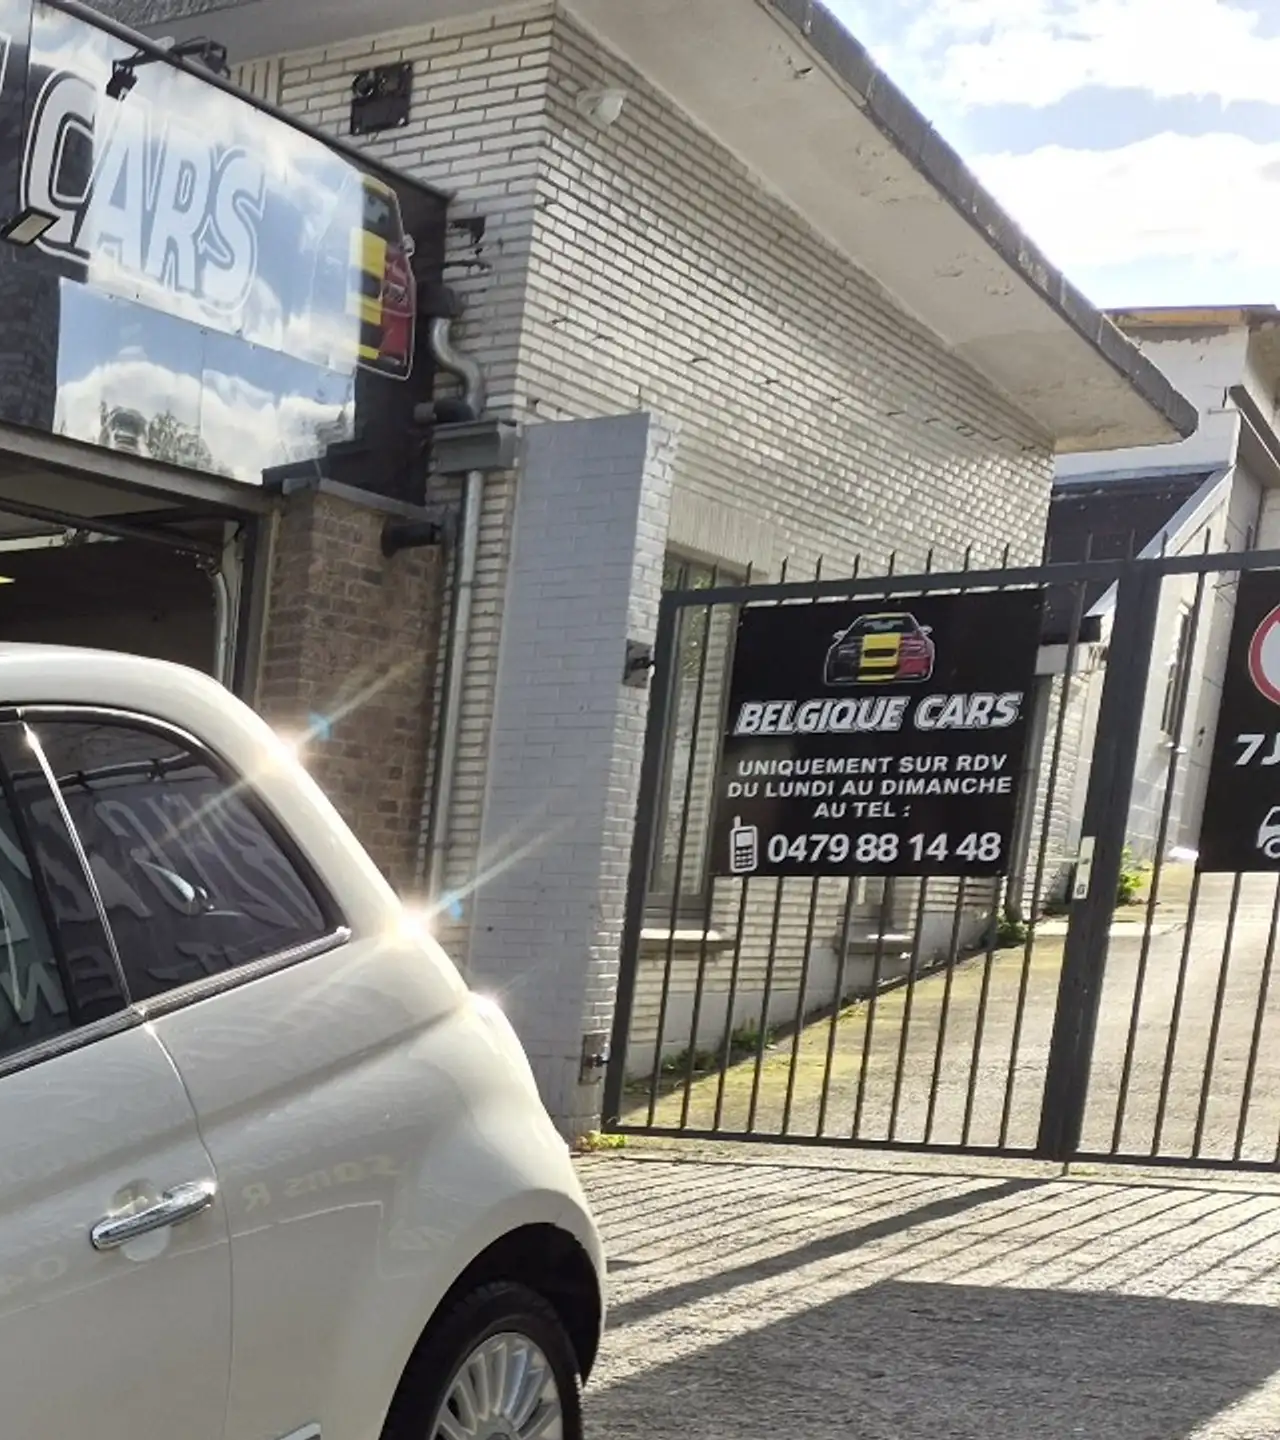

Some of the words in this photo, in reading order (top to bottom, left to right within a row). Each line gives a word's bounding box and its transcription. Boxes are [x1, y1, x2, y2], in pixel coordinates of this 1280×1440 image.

[21, 64, 267, 317] CARS
[734, 695, 912, 736] BELGIQUE
[915, 692, 1022, 730] CARS
[737, 756, 891, 777] UNIQUEMENT
[898, 754, 949, 774] SUR
[954, 753, 1007, 772] RDV
[727, 782, 759, 799] DU
[763, 781, 834, 799] LUNDI
[840, 780, 877, 798] AU
[881, 776, 1012, 797] DIMANCHE
[812, 802, 848, 819] AU
[853, 801, 896, 818] TEL
[767, 834, 849, 863] 0479
[855, 834, 899, 861] 88
[908, 833, 947, 861] 14
[954, 832, 1002, 861] 48
